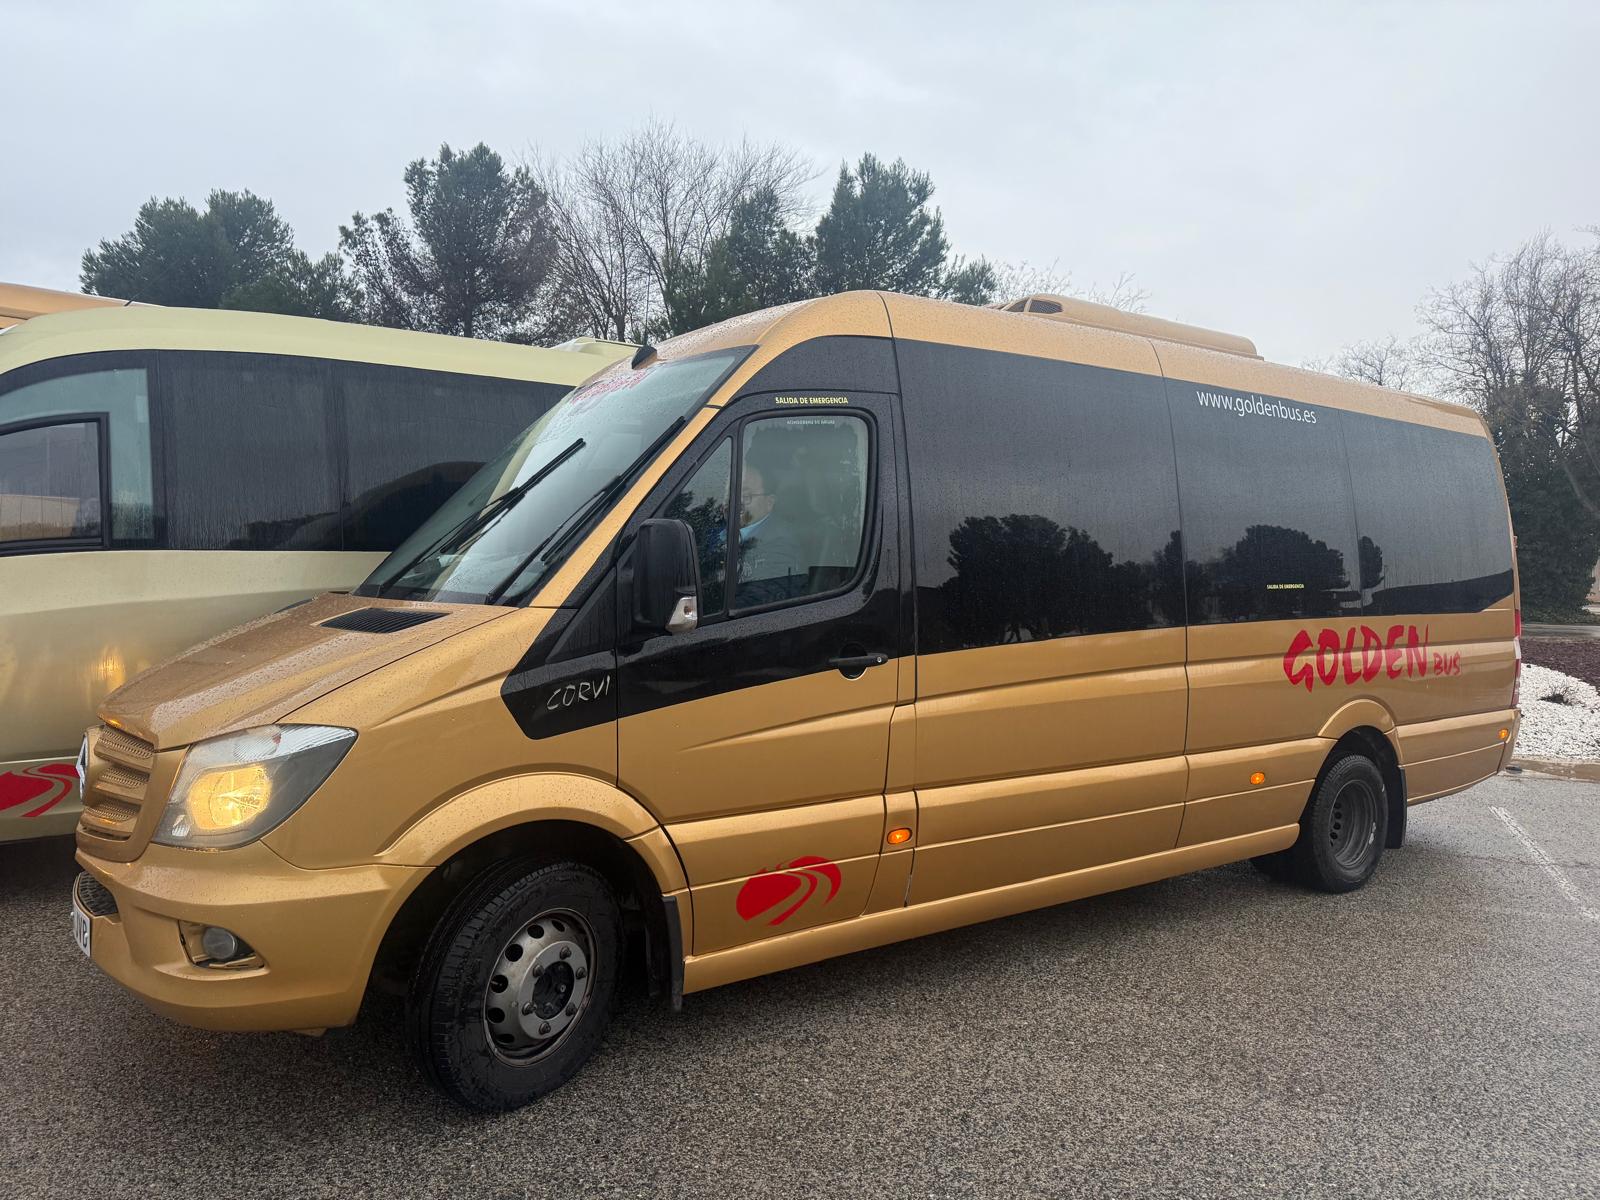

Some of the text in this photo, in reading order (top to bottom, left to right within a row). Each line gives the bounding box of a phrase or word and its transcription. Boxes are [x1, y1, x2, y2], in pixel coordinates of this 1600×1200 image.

[775, 396, 799, 404] SALIDA
[800, 396, 808, 404] DE
[1196, 391, 1317, 424] www.goldenbus.es
[1282, 624, 1461, 693] GOLDEN BUS
[546, 675, 611, 710] CORVI
